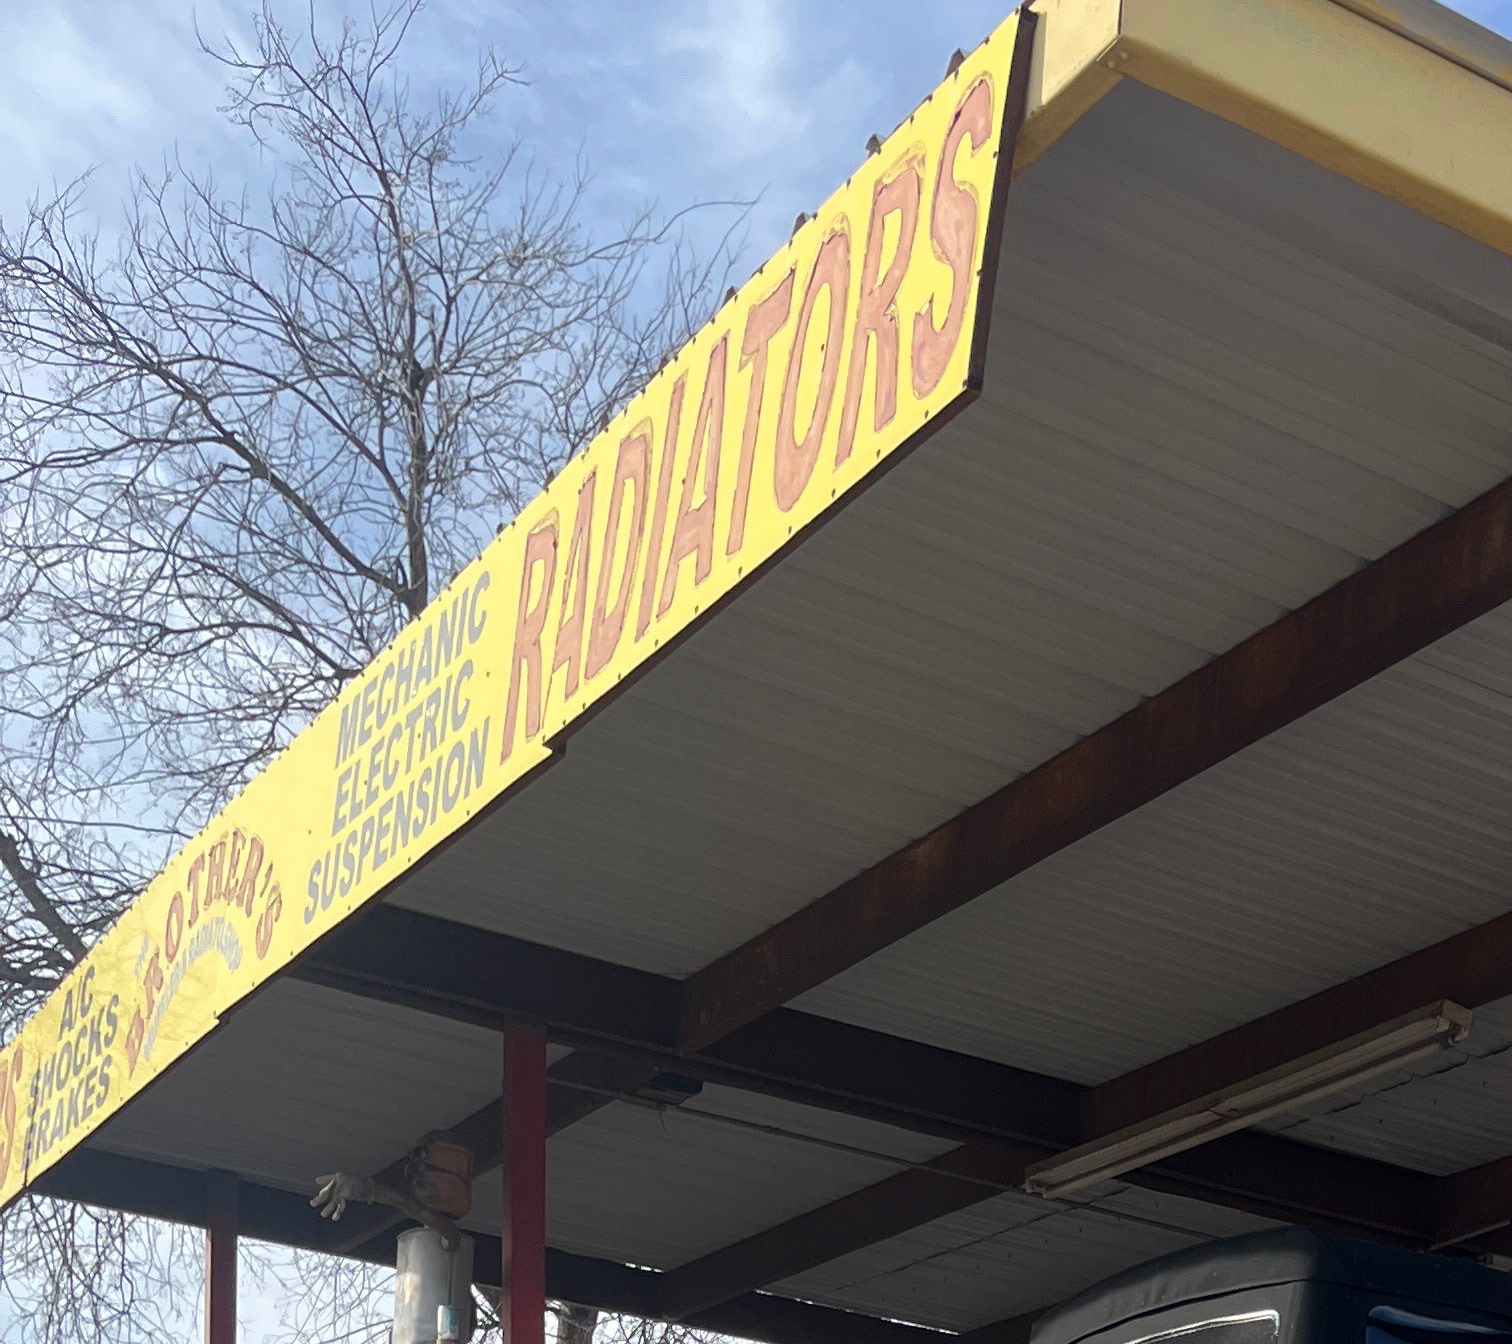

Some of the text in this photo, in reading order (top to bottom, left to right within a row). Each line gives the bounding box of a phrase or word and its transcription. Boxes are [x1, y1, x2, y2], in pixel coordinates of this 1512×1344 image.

[501, 70, 995, 766] RADIATORS
[331, 659, 474, 837] ELECTRIC
[335, 570, 490, 769] MECHANIC
[304, 716, 491, 924] SUSPENSION
[27, 994, 119, 1120] SHOCKS
[57, 965, 95, 1041] A/C
[21, 1055, 113, 1173] BRAKES
